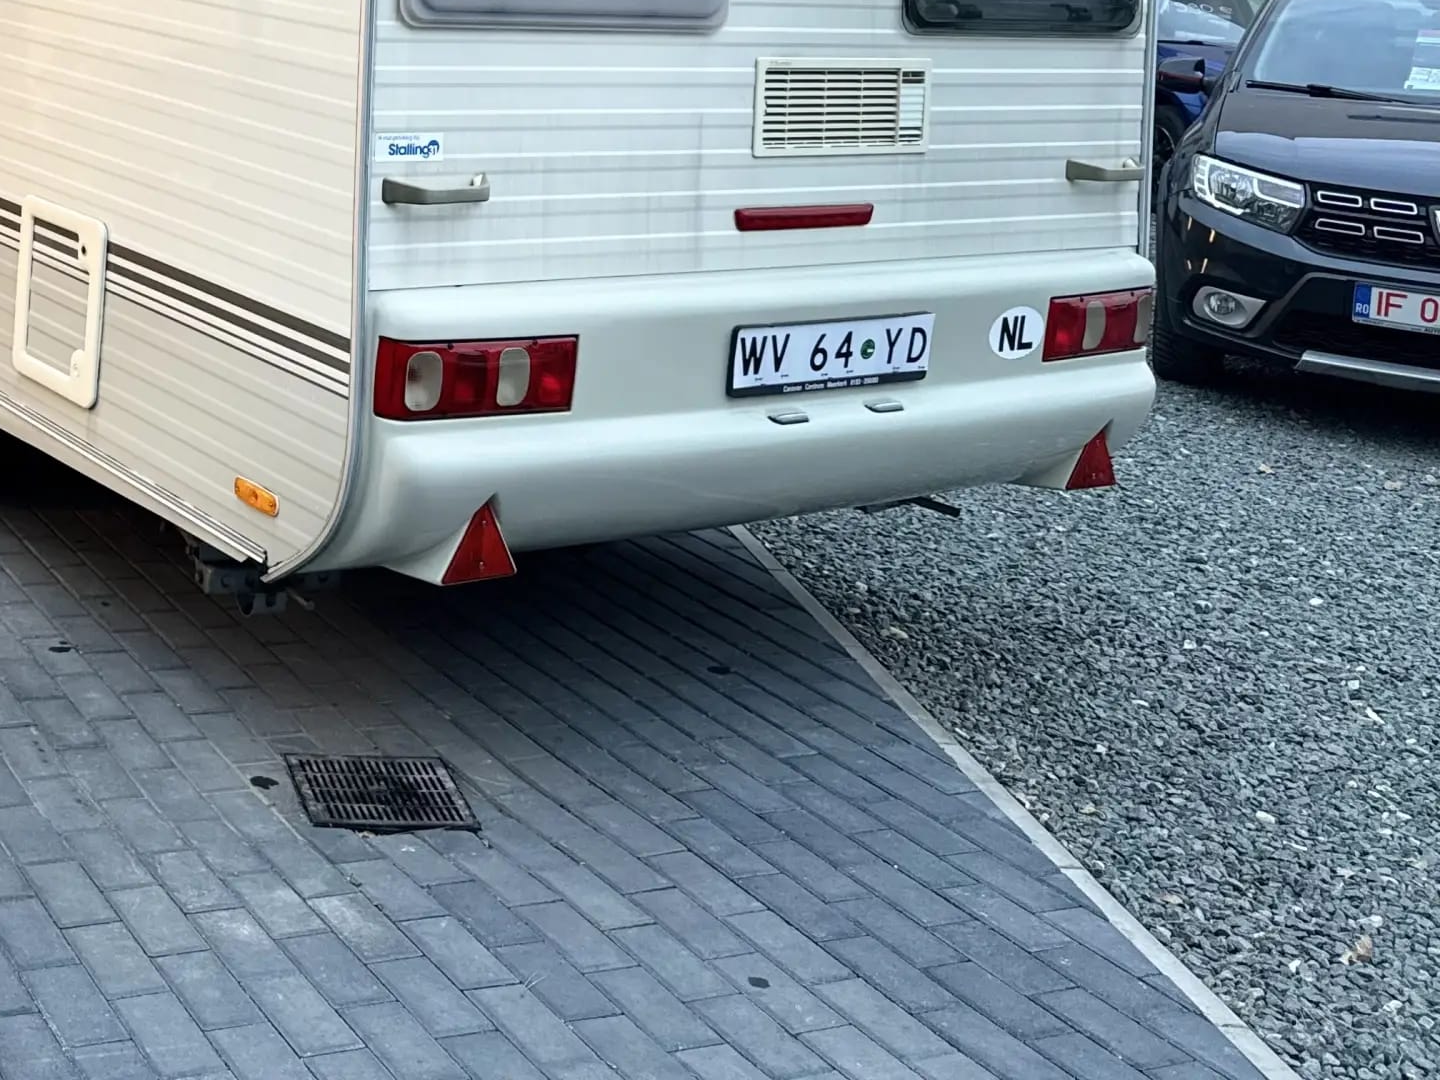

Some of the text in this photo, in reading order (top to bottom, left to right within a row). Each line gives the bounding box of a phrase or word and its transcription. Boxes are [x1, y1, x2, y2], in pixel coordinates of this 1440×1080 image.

[388, 143, 430, 158] Stalling
[1355, 303, 1369, 314] RO
[1376, 291, 1408, 317] IF
[998, 314, 1032, 352] NL
[740, 327, 927, 376] WV 64 YD
